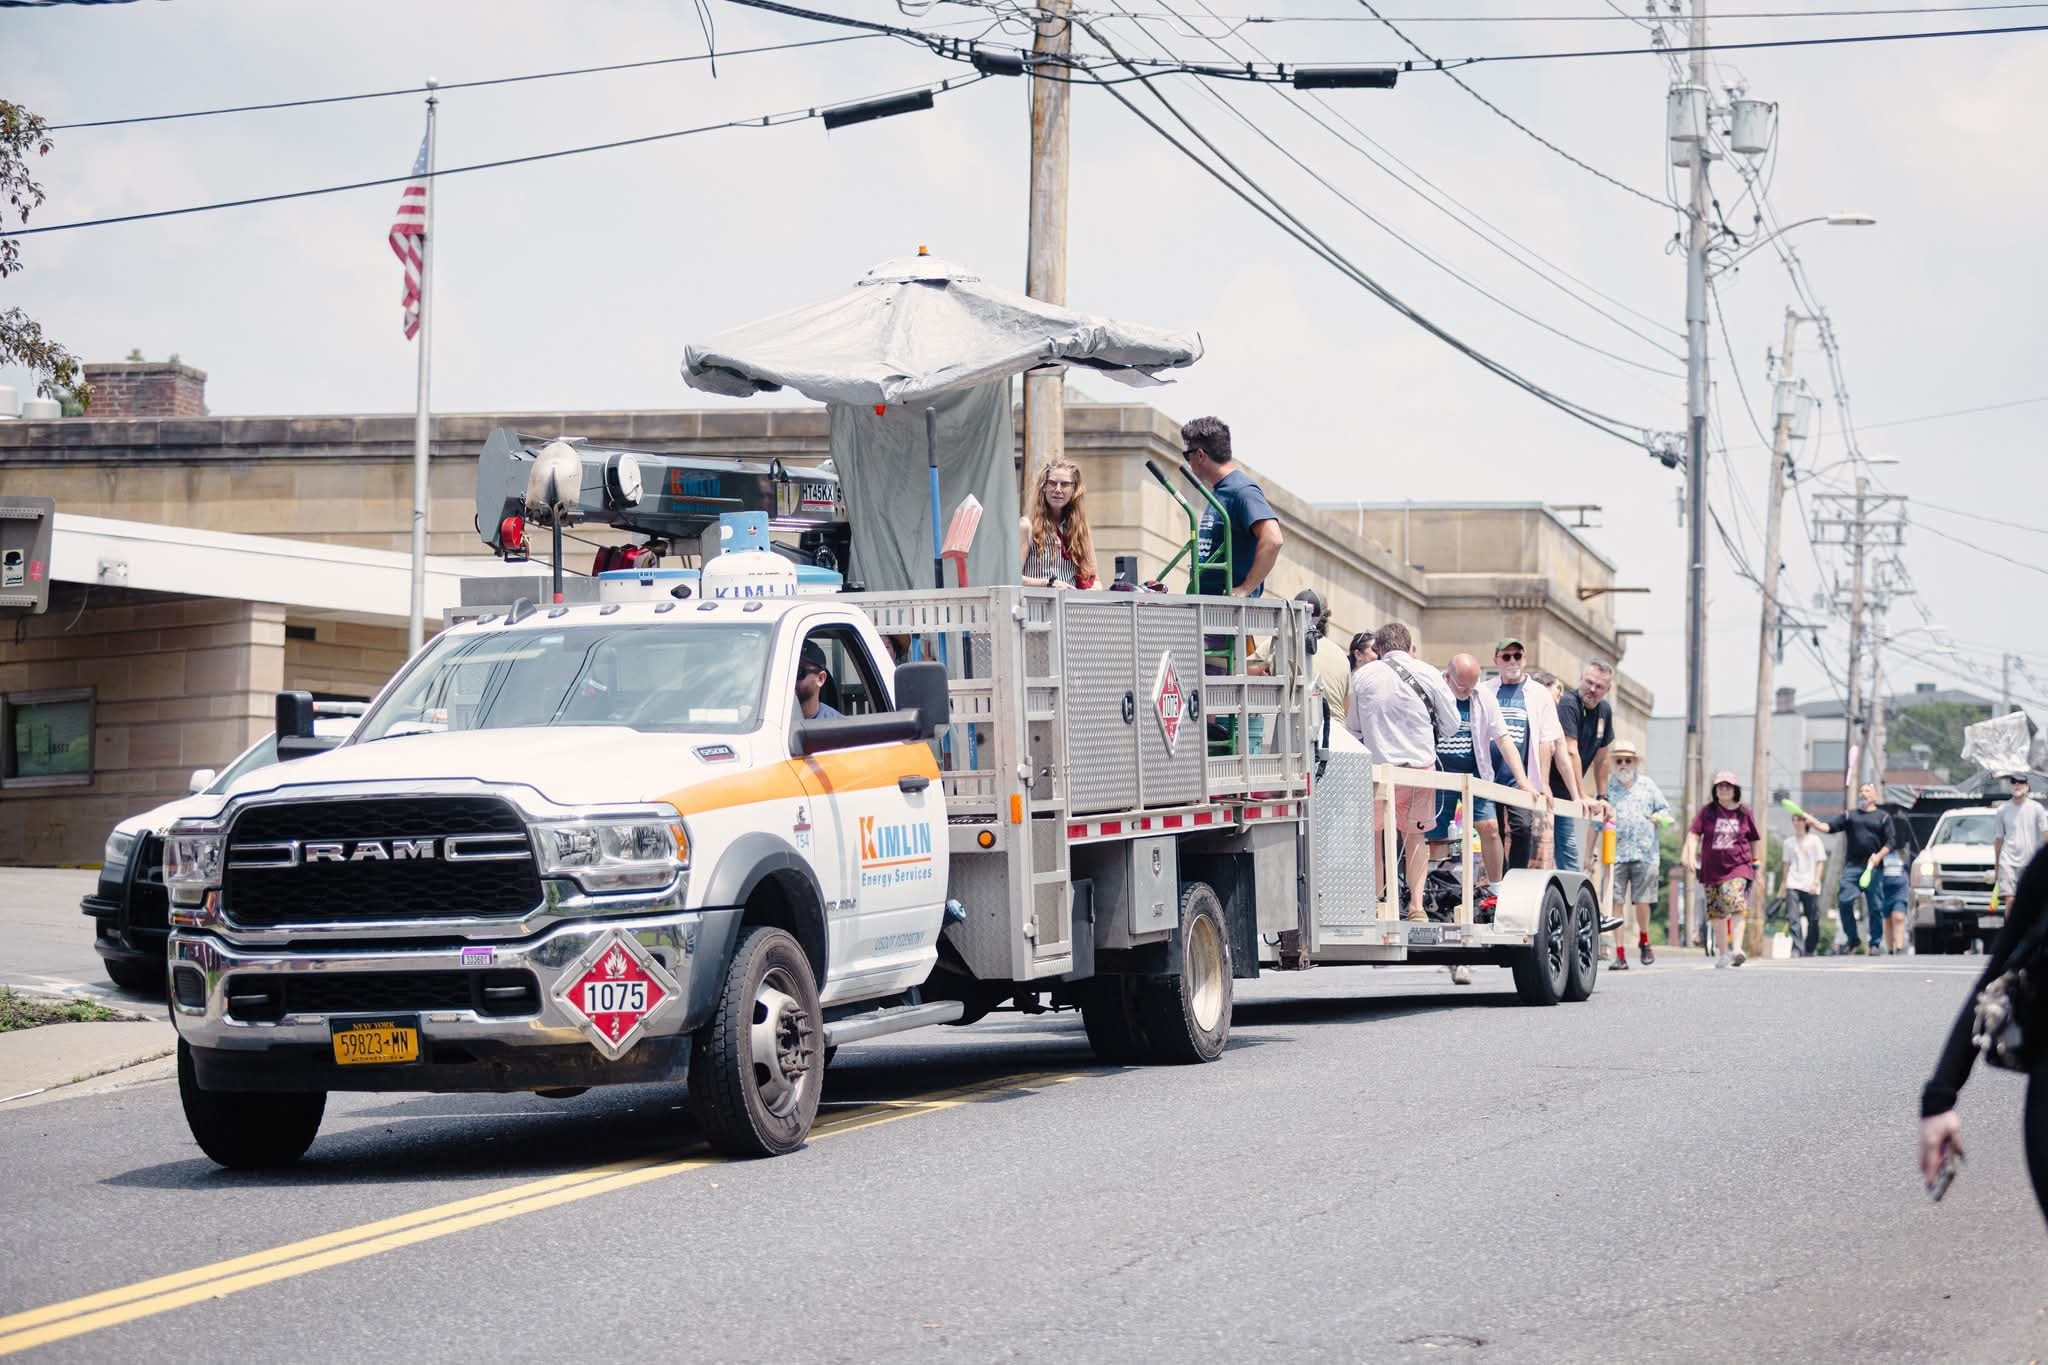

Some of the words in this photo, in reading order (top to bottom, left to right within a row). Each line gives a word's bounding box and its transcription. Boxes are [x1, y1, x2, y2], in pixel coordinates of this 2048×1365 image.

[803, 484, 833, 500] HT45KX
[859, 816, 932, 861] KIMLIN
[305, 840, 435, 862] RAM
[861, 871, 892, 887] Energy
[895, 867, 933, 882] Services
[588, 983, 645, 1011] 1075
[352, 1023, 373, 1031] NEW
[374, 1021, 396, 1030] YORK
